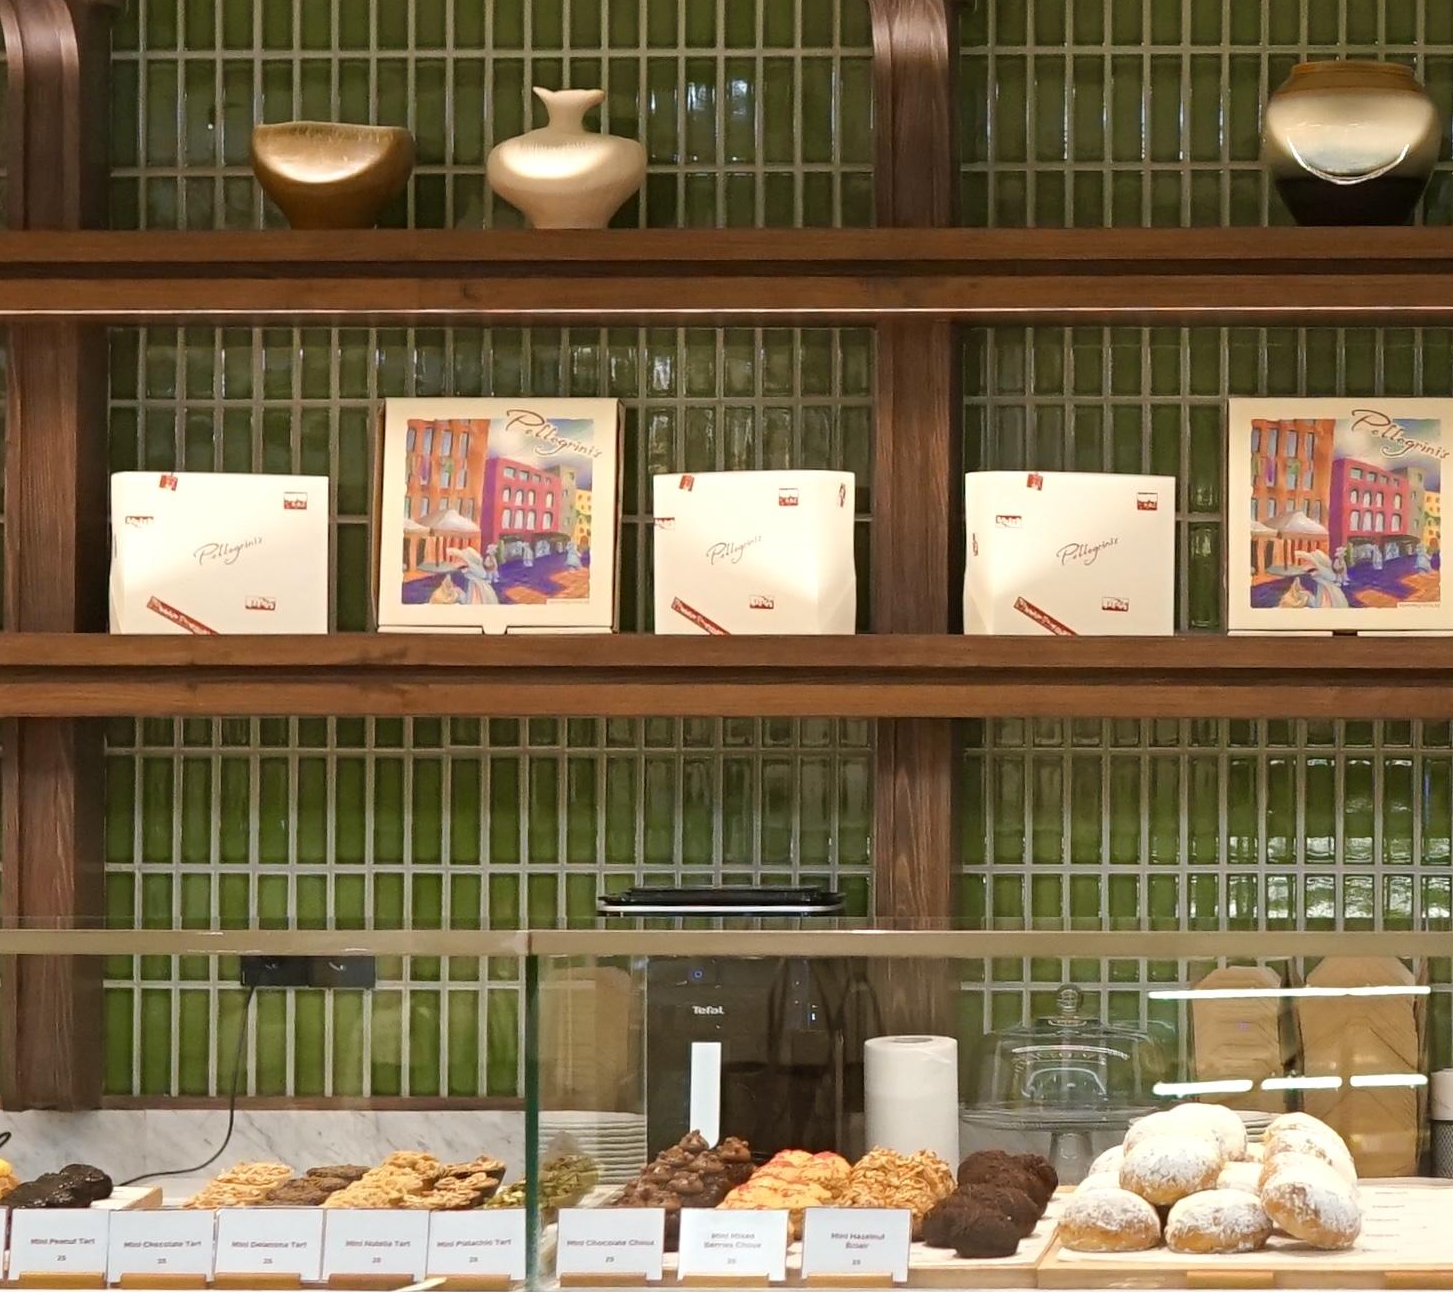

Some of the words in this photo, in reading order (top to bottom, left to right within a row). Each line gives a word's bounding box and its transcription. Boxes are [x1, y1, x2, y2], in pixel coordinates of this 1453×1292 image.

[505, 408, 603, 459] Pellegrini's
[1350, 408, 1451, 460] Pellegrini's
[692, 1005, 725, 1015] Tefal
[729, 1232, 755, 1240] Mixed
[78, 1237, 96, 1245] Tart
[185, 1240, 202, 1248] Tart
[456, 1238, 493, 1247] Pistachio
[495, 1238, 512, 1246] Tart
